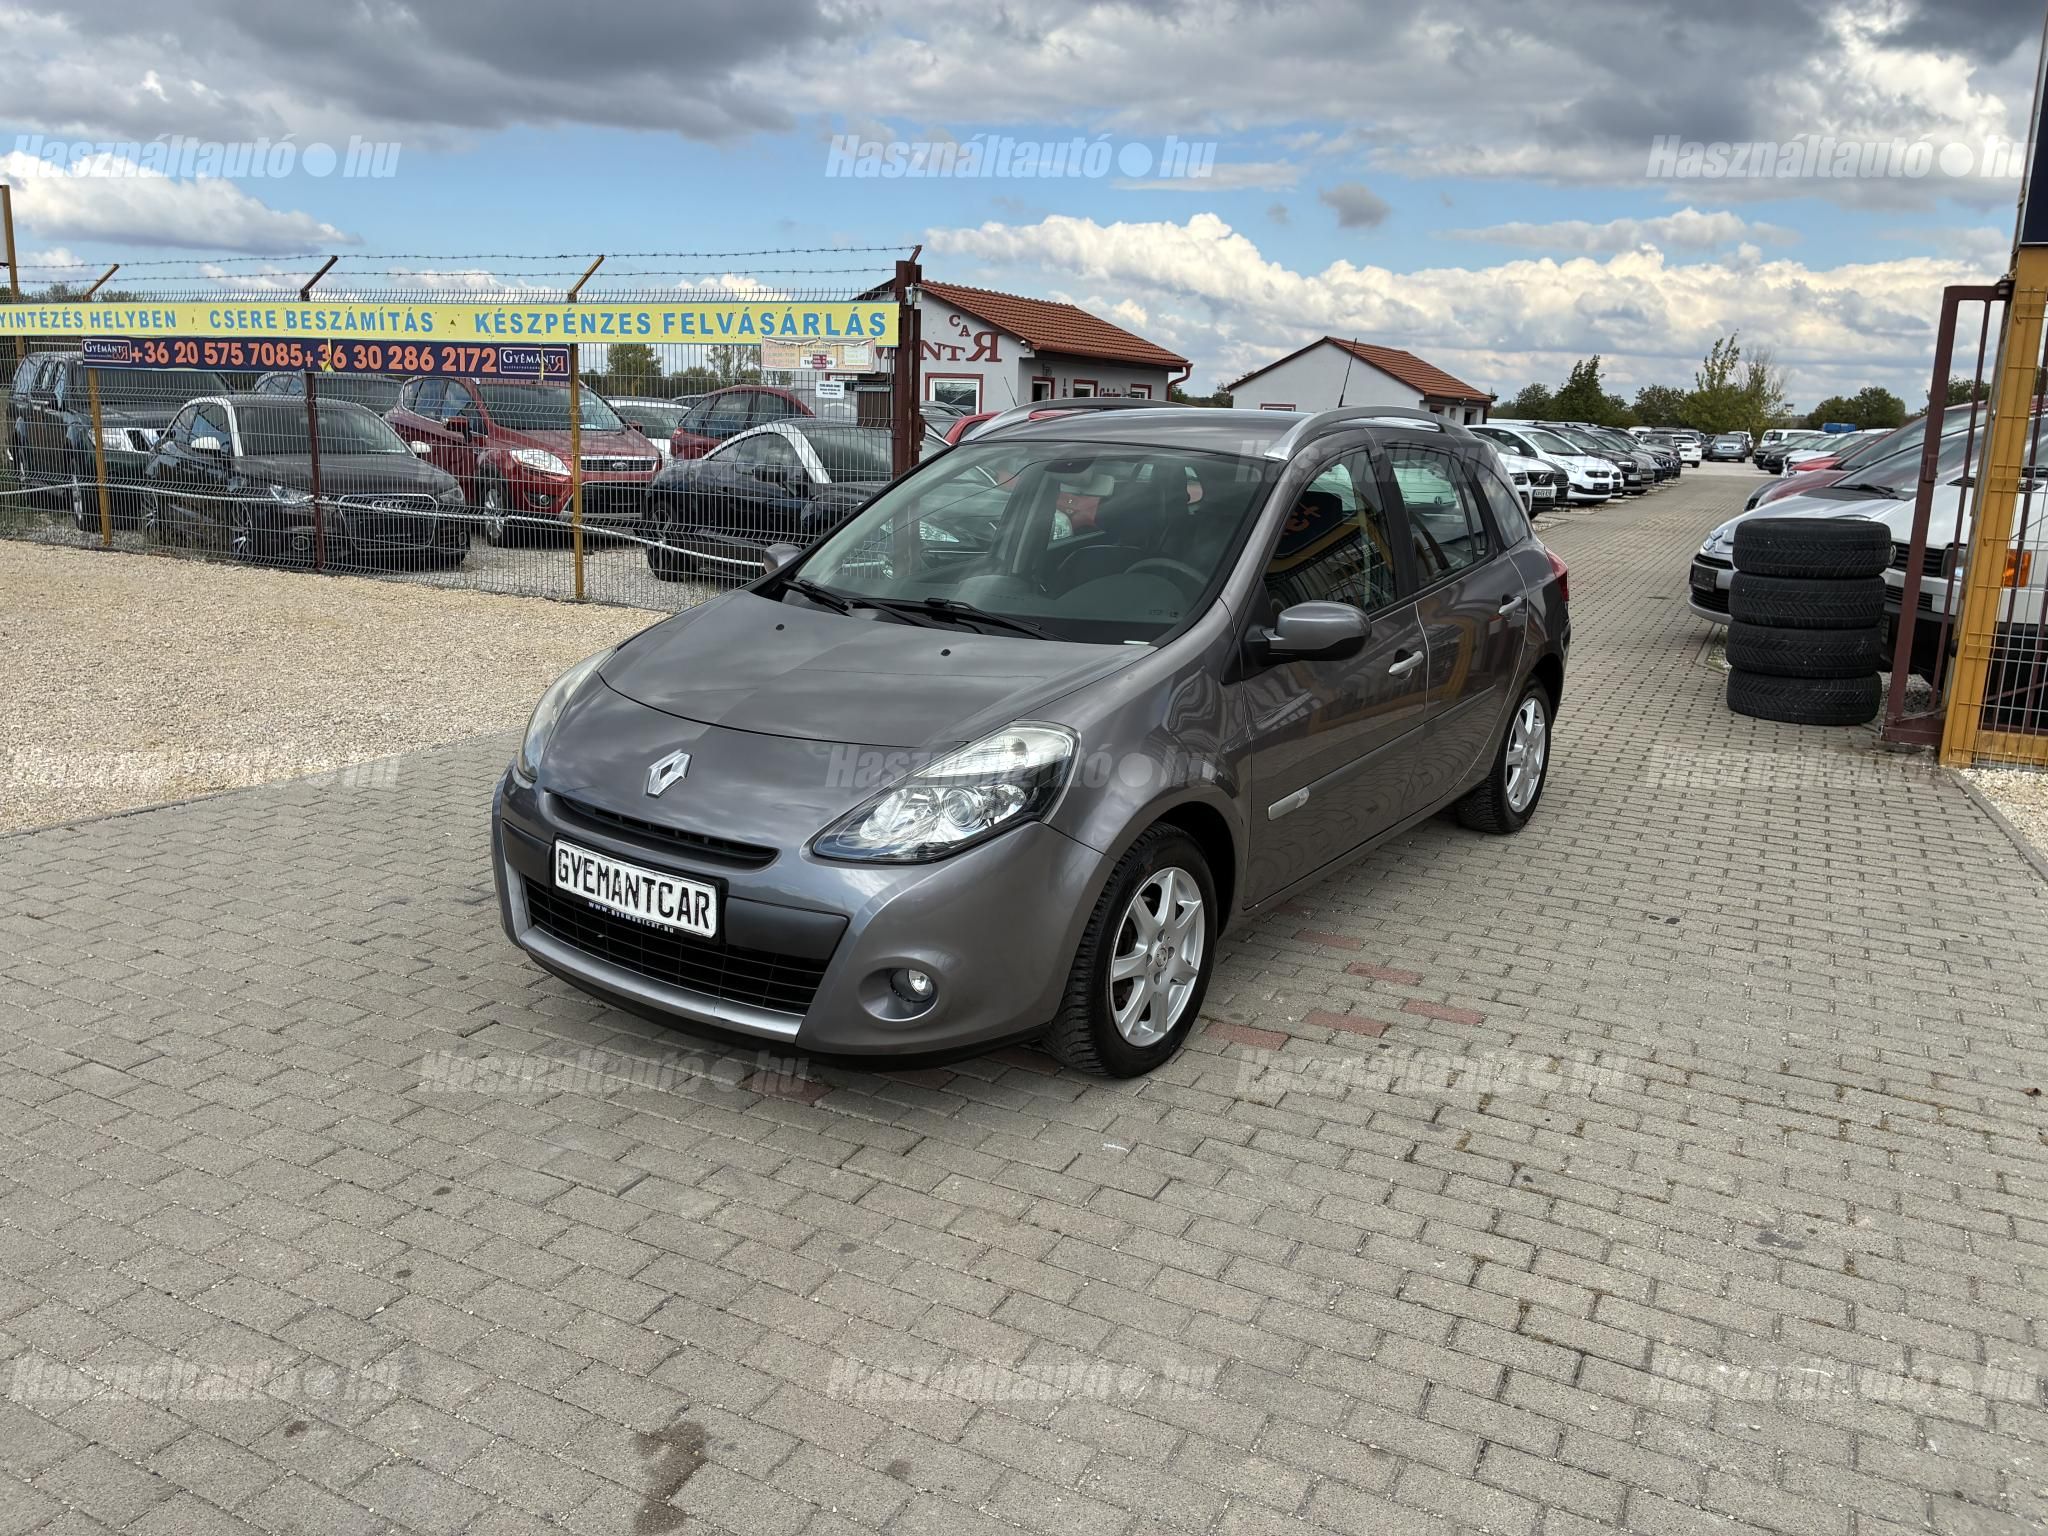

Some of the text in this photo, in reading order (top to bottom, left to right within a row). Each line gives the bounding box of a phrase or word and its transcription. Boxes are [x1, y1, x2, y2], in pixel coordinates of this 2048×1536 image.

[90, 310, 177, 329] HELYBEN
[209, 310, 278, 329] CSERE
[286, 306, 434, 333] BESZÁMÍTÁS
[474, 307, 651, 334] KÉSZPÉNZES
[663, 307, 886, 336] FELVÁSÁRLÁS
[174, 341, 199, 365] 20
[204, 343, 244, 366] 575
[353, 345, 382, 370] 30
[387, 346, 435, 372] 286
[441, 347, 497, 373] 2172
[557, 848, 710, 930] GYEMANTCAR
